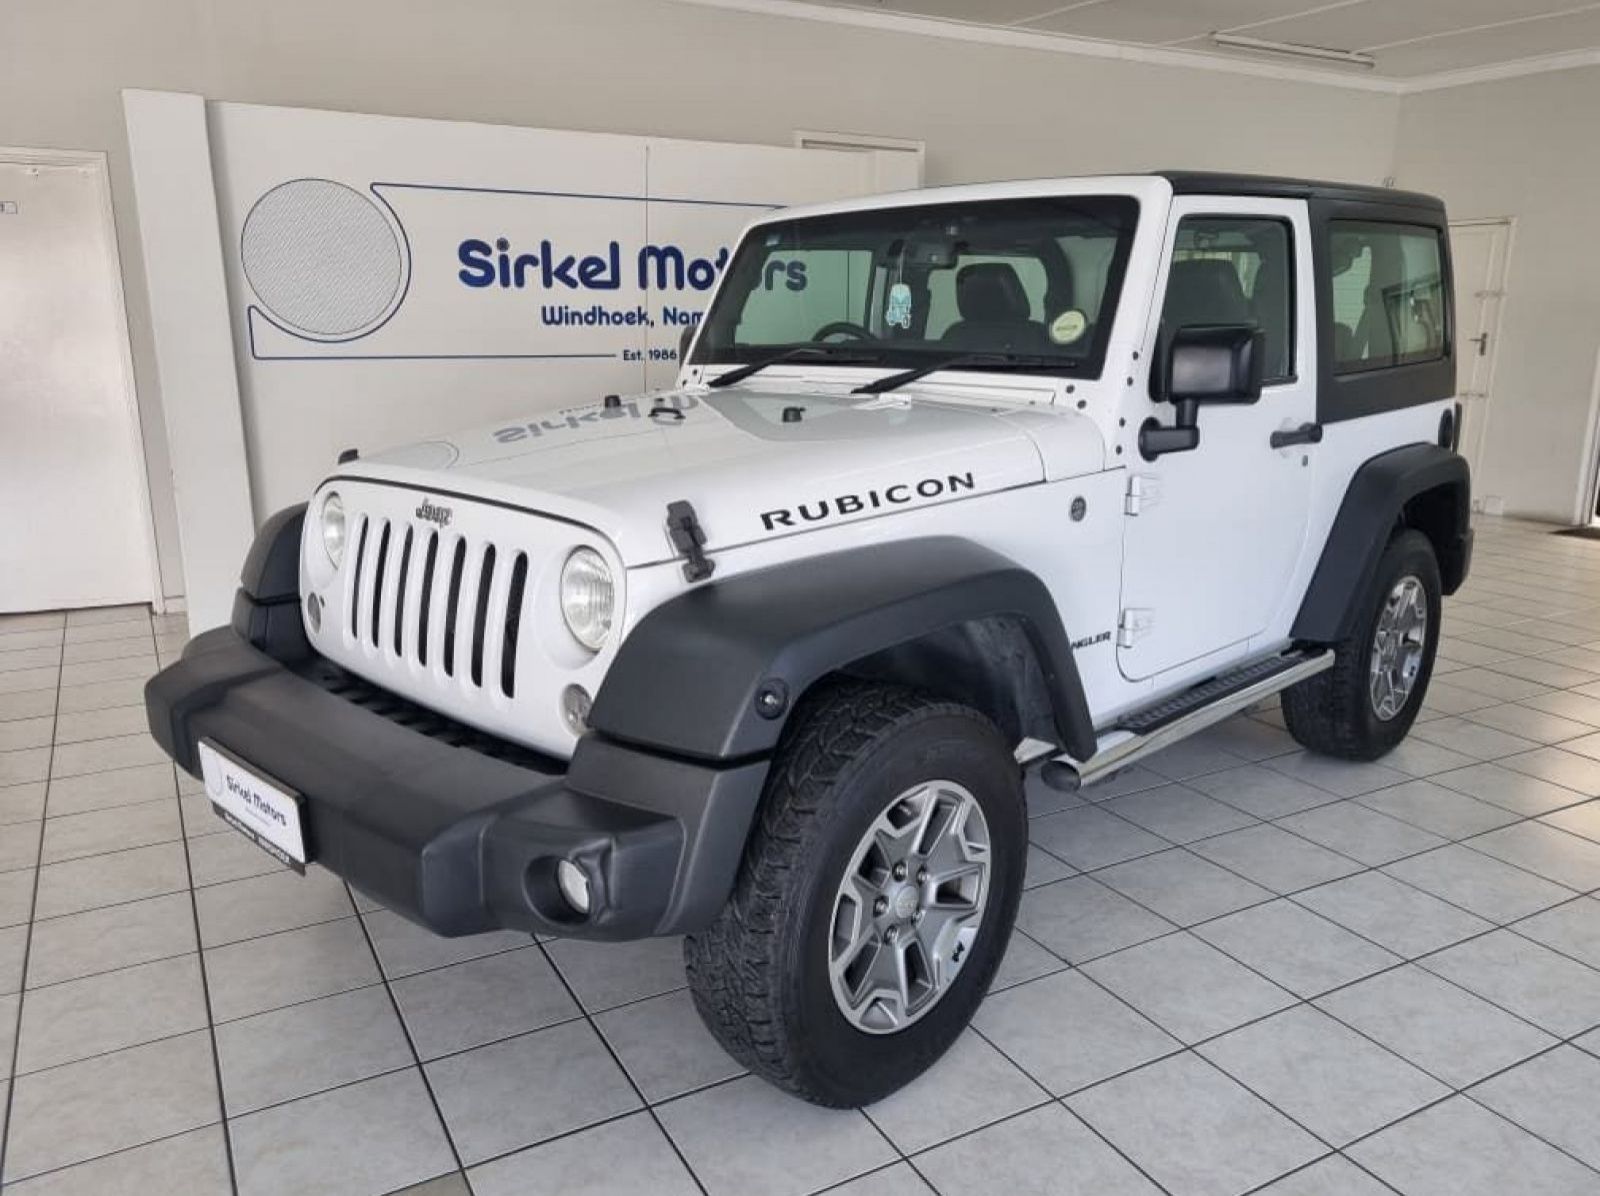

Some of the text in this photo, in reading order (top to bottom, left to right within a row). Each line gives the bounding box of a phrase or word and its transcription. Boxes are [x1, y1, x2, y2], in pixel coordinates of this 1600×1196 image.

[457, 238, 808, 291] Sirkel Motrs
[541, 305, 655, 328] Windhoek,
[622, 349, 678, 361] Est. 1986
[760, 472, 976, 530] RUBICON
[1071, 631, 1111, 649] NGLER
